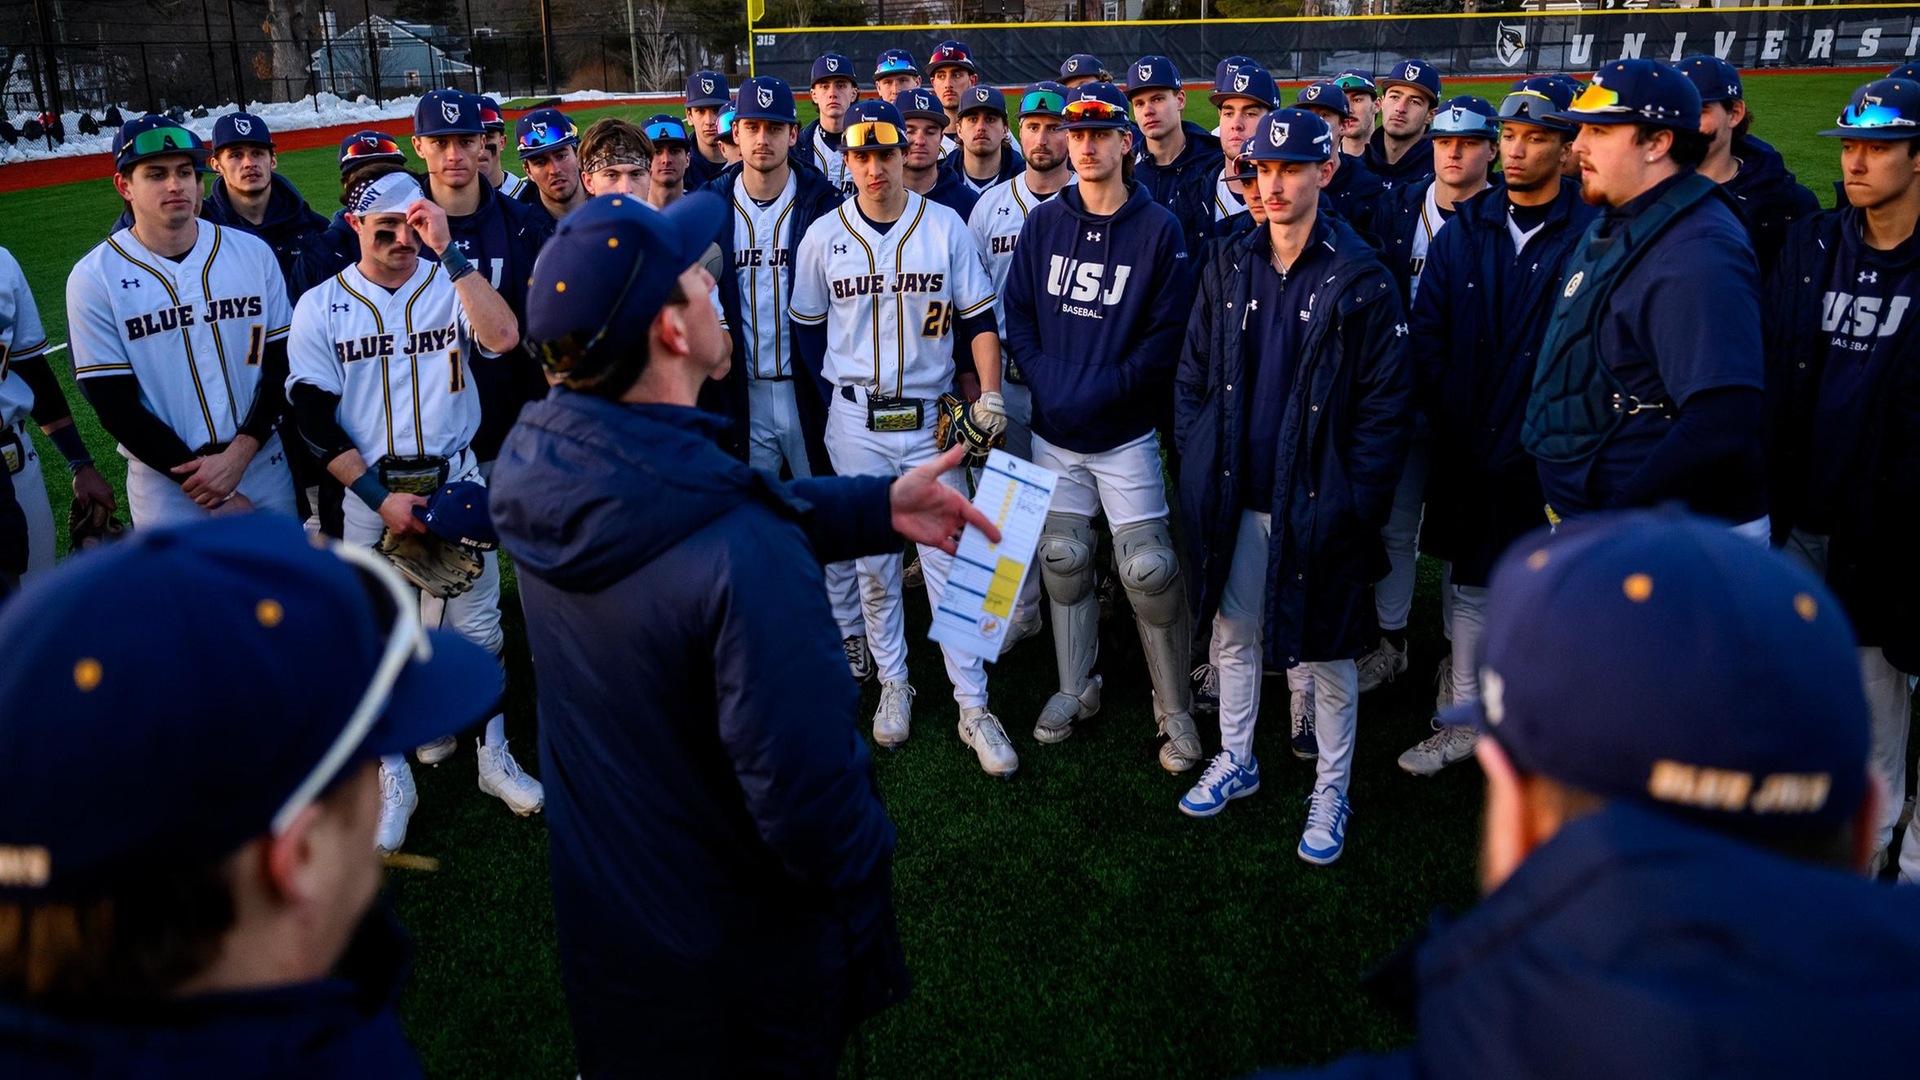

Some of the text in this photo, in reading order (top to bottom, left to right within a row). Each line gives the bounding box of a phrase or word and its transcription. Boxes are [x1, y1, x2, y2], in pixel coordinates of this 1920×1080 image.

[756, 34, 776, 46] 315
[832, 272, 944, 299] BLUE JAYS
[1046, 254, 1132, 306] USJ
[124, 295, 263, 342] BLUE JAYS
[921, 300, 952, 339] 26
[1821, 291, 1911, 338] USJ
[335, 321, 457, 364] BLUE JAYS
